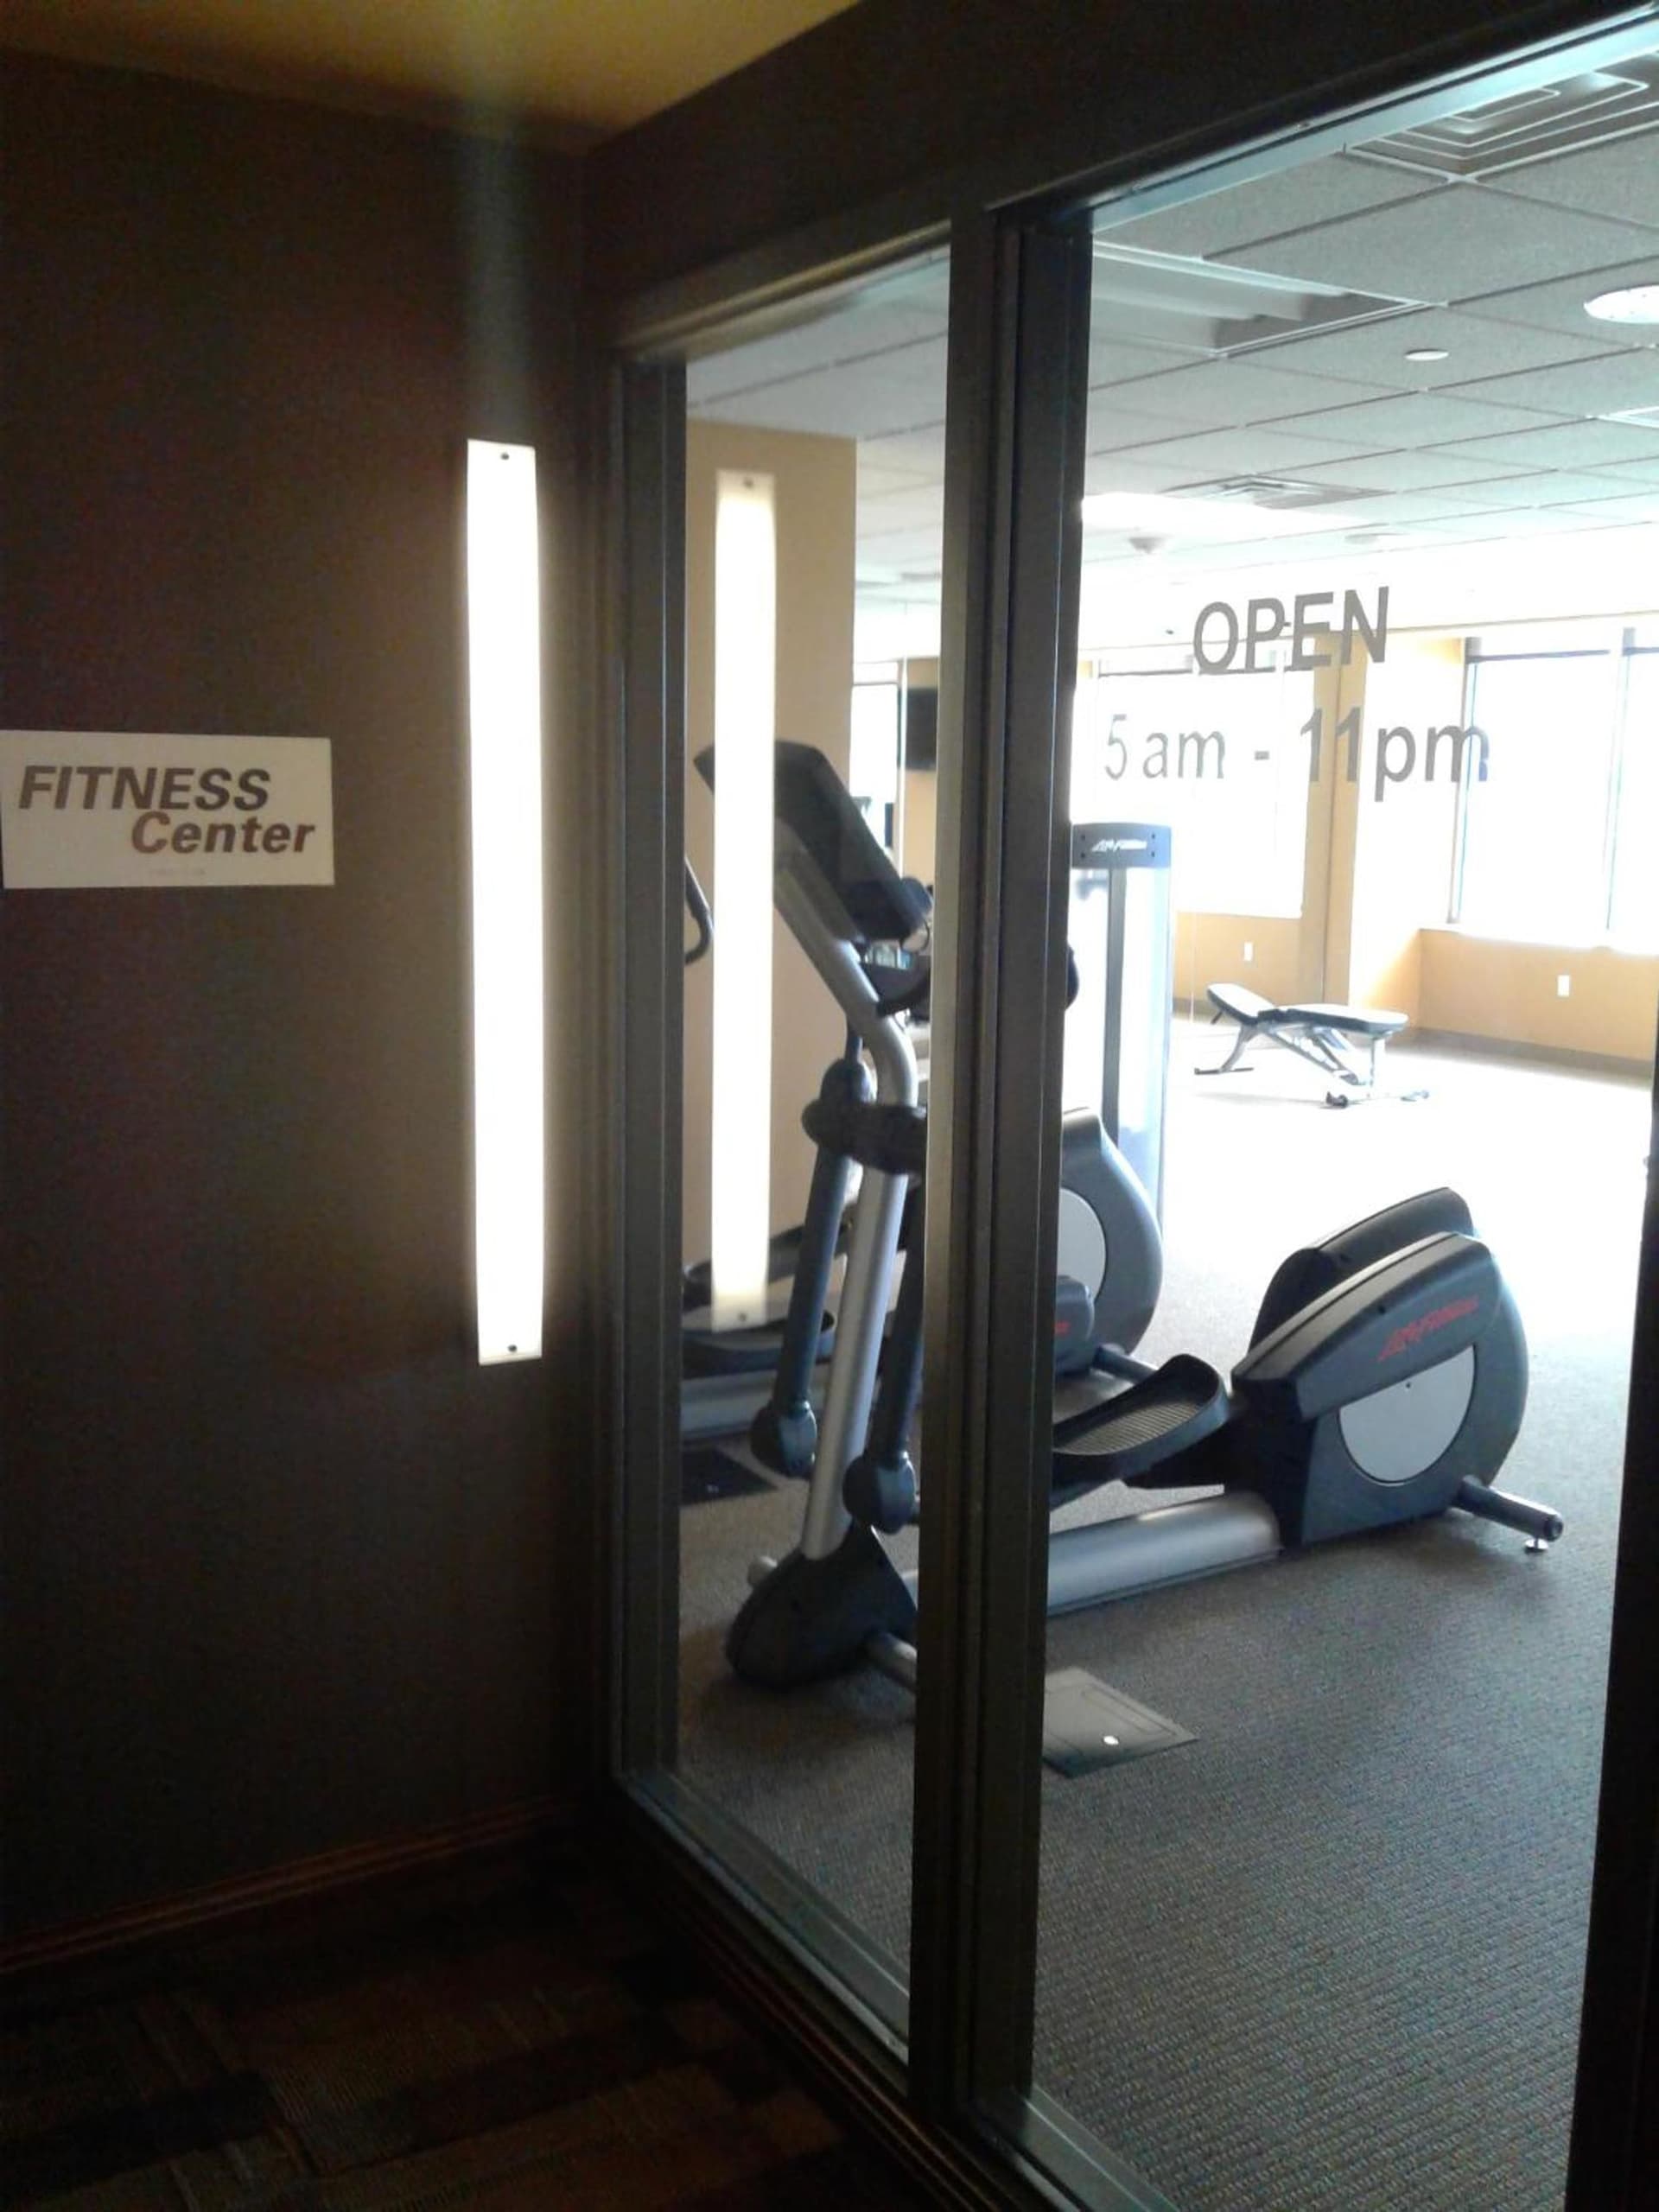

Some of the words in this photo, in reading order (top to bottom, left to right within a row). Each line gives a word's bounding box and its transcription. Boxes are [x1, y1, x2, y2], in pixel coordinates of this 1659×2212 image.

[1193, 586, 1389, 675] OPEN
[18, 765, 271, 810] FITNESS
[130, 810, 315, 854] Center
